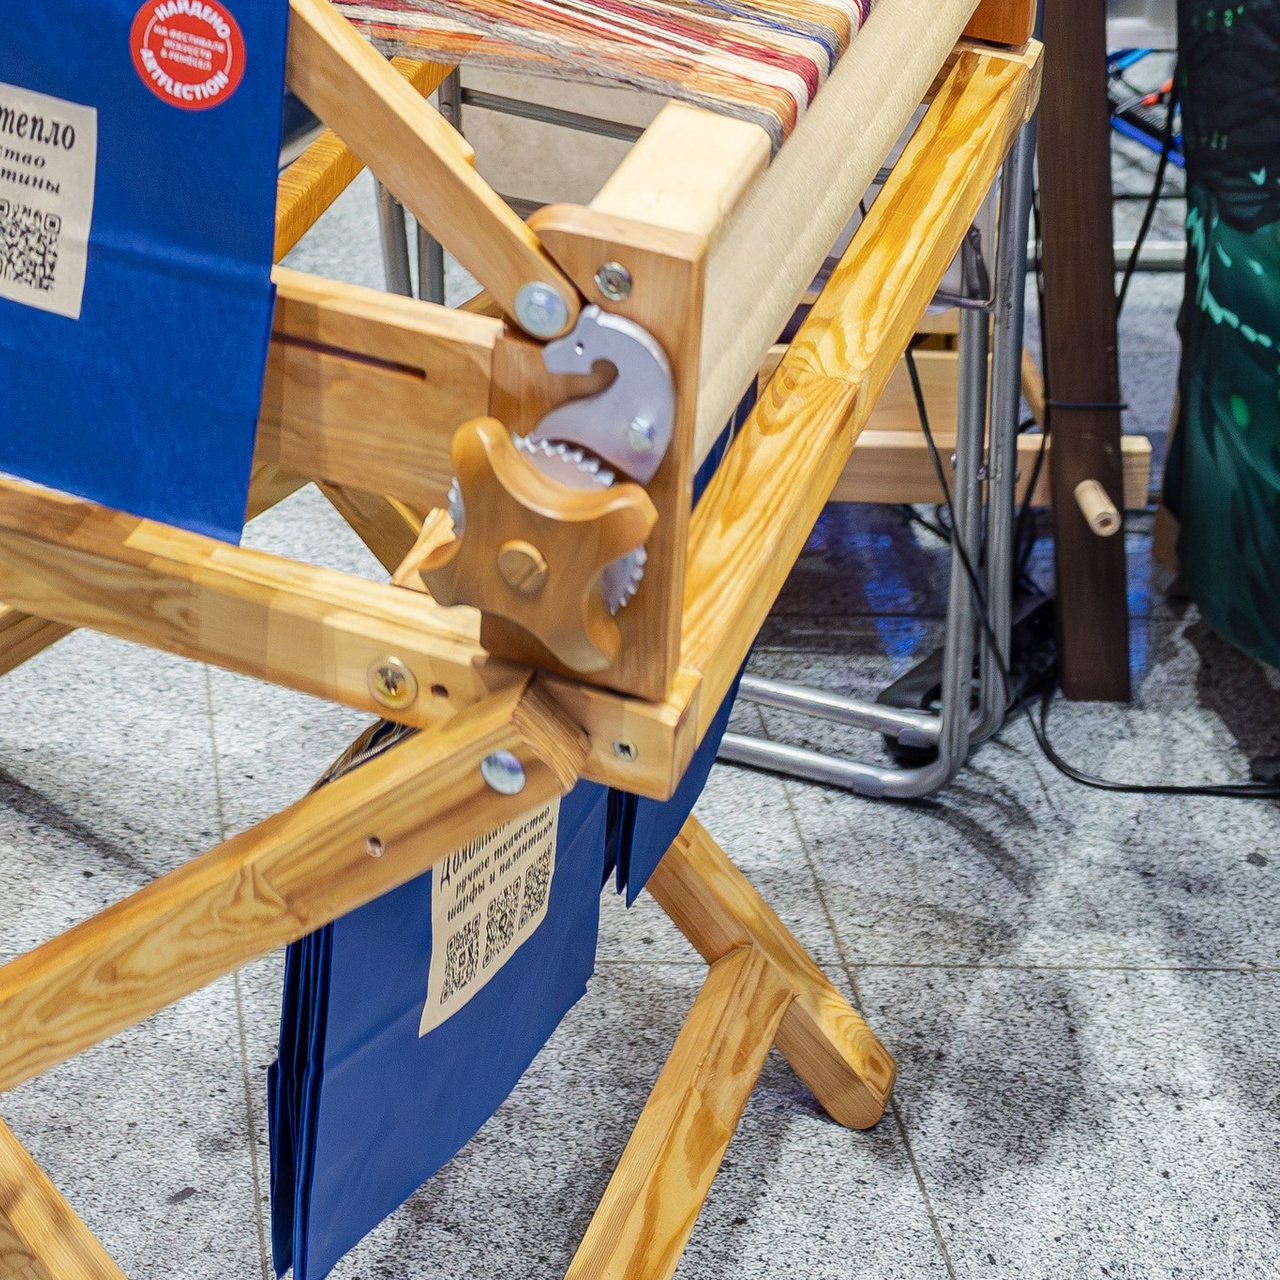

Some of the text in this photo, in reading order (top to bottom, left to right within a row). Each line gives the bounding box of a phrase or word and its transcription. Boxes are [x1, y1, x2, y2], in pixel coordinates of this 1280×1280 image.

[140, 48, 230, 101] ARTFLECTION
[455, 806, 550, 900] ручное ткачество
[447, 880, 485, 922] шарфы
[489, 871, 496, 885] и
